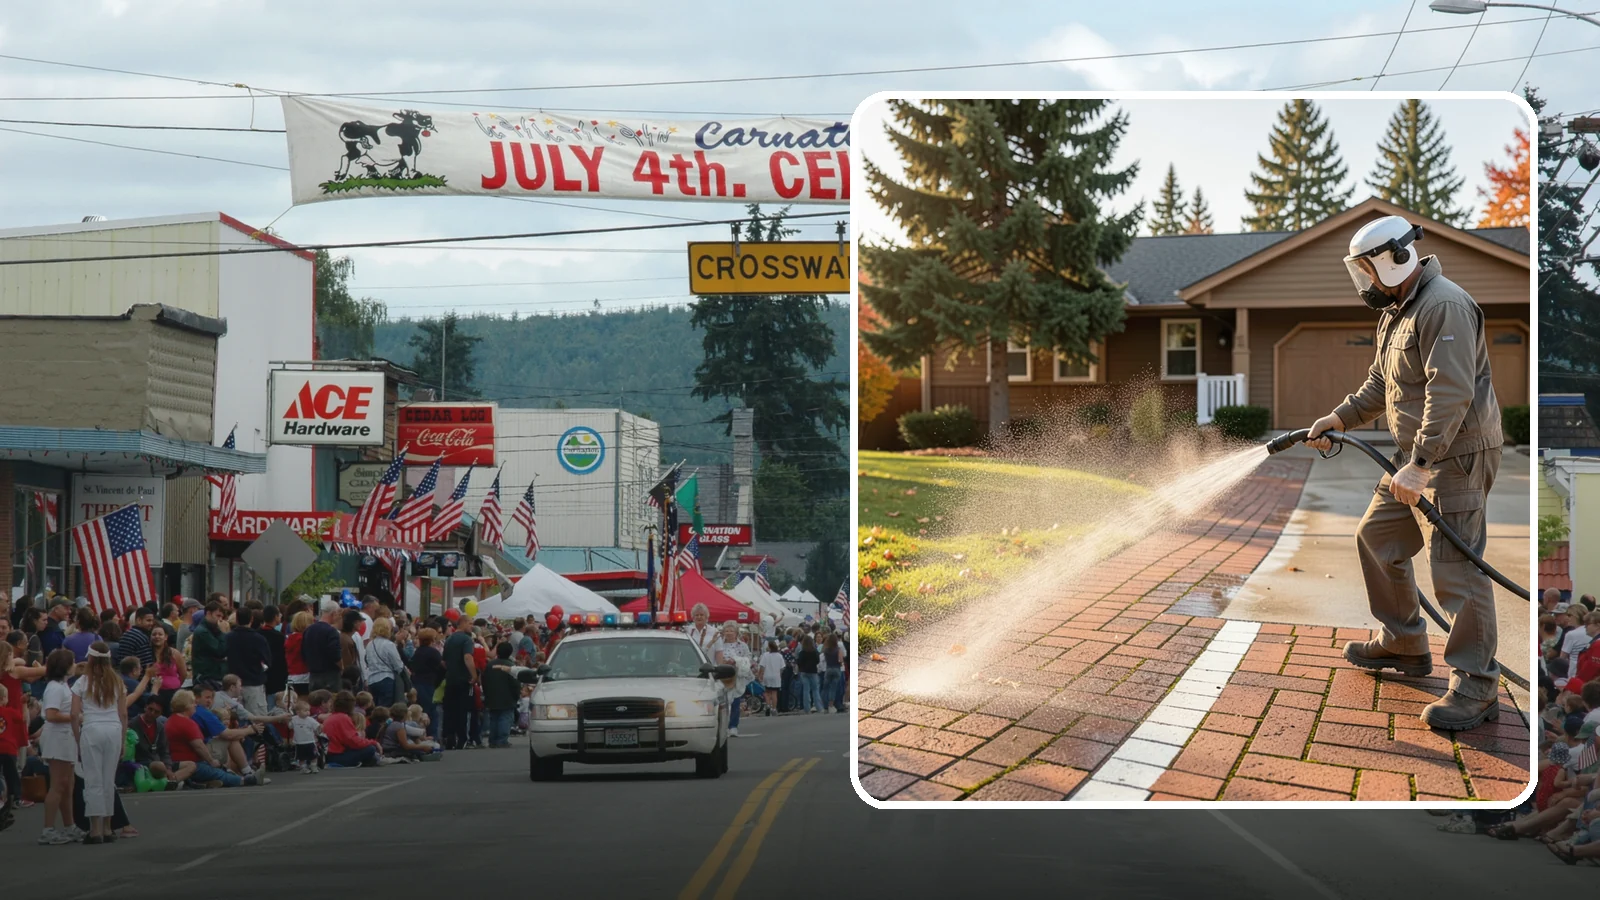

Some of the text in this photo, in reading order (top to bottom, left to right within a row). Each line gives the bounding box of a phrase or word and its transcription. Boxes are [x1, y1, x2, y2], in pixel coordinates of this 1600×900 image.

[695, 121, 850, 149] Carnat
[481, 141, 604, 191] JULY
[632, 150, 746, 197] 4th.
[697, 254, 850, 280] CROSSWA
[283, 380, 373, 420] ACE
[406, 409, 485, 421] CEDAR LOG
[284, 421, 370, 436] Hardware
[354, 467, 386, 479] Simpl
[95, 485, 124, 495] Vincent
[126, 486, 136, 494] de
[138, 486, 155, 495] Paul
[699, 535, 730, 543] GLASS
